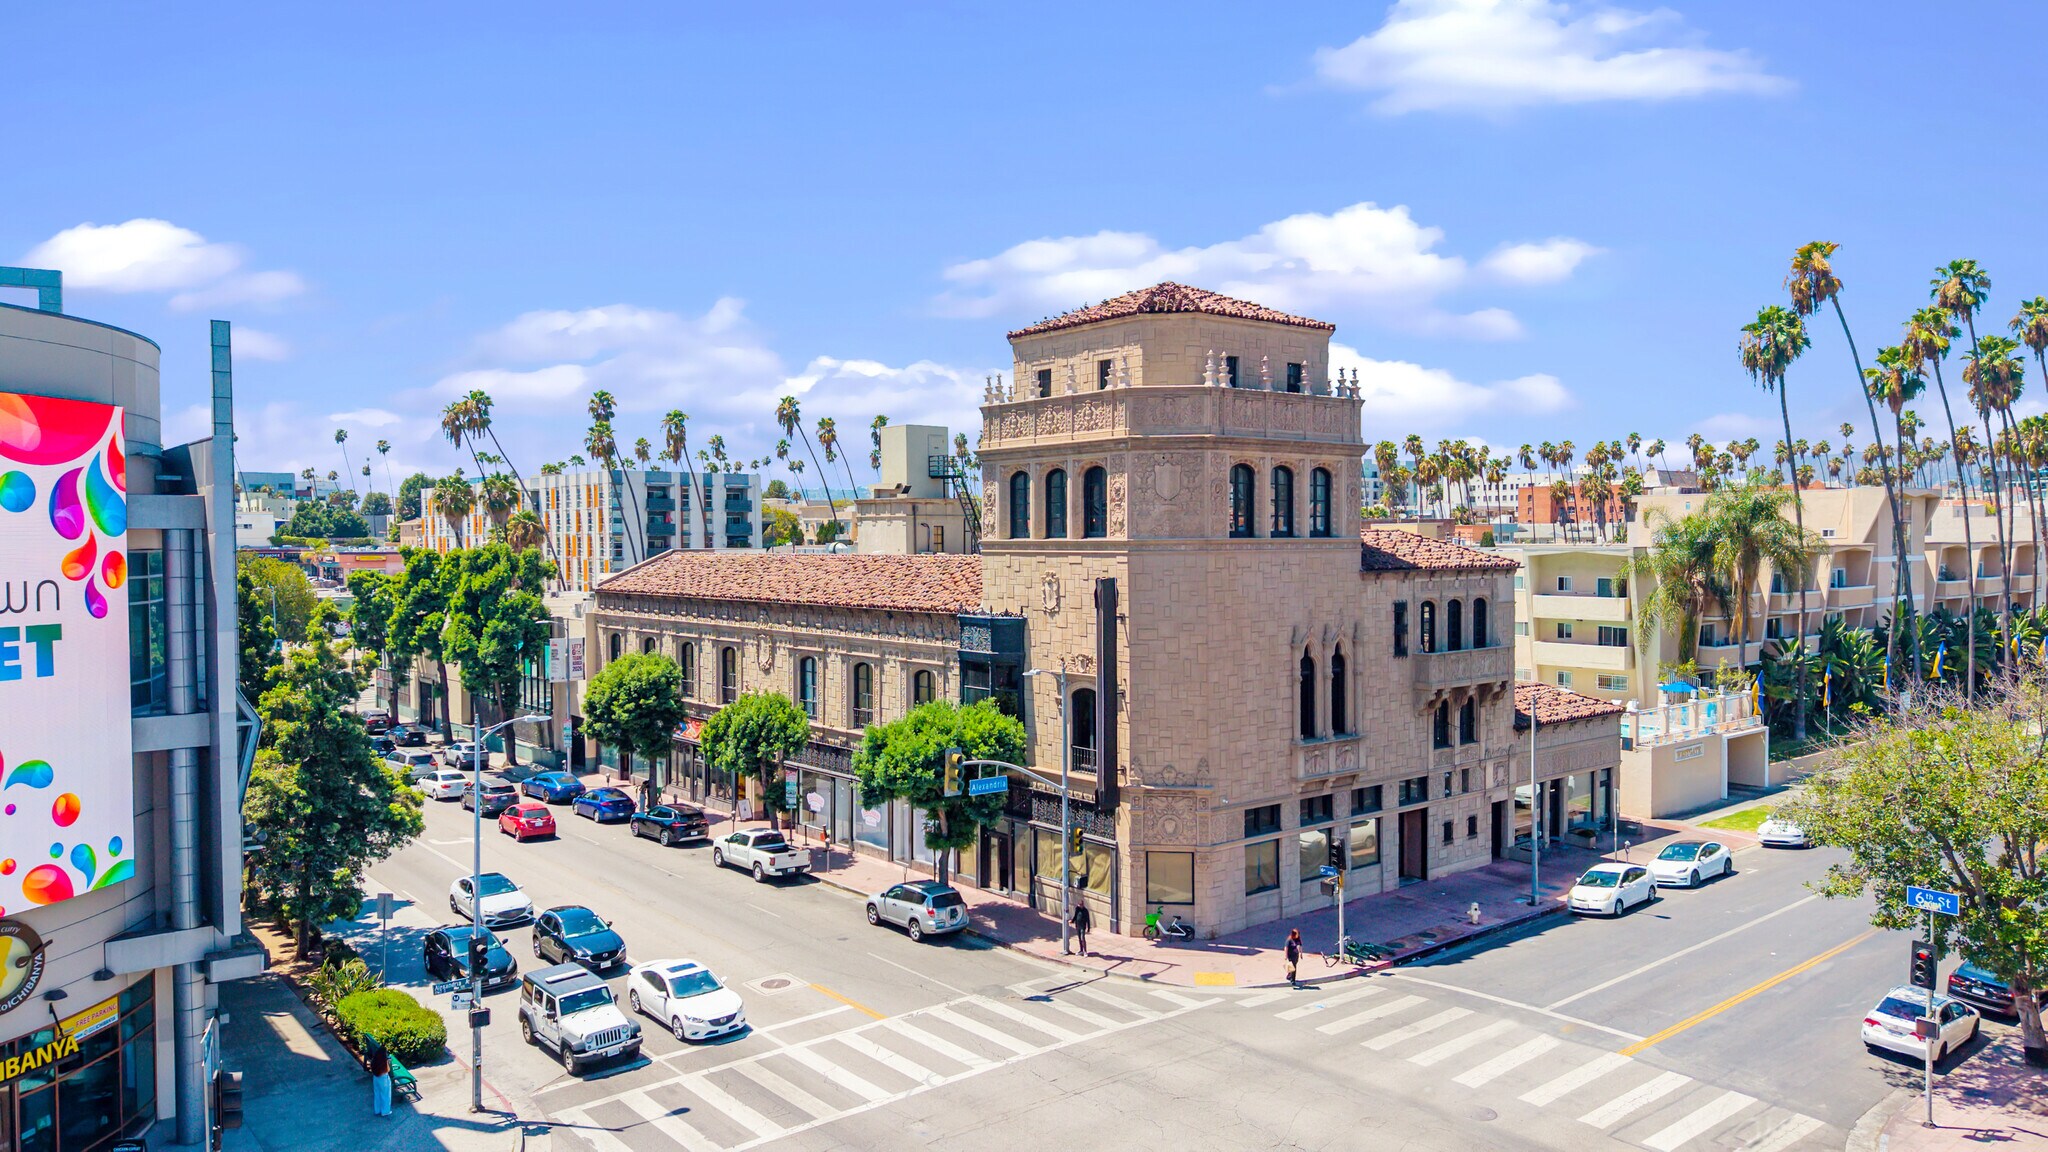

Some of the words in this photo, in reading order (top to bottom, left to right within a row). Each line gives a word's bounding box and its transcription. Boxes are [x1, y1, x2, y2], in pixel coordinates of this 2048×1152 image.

[0, 623, 62, 681] ET
[971, 781, 1006, 791] Alexandria
[1915, 892, 1934, 905] 6th
[1938, 897, 1951, 909] St
[1, 926, 20, 934] curry
[76, 1015, 90, 1028] FREE
[92, 1004, 117, 1020] PARKING
